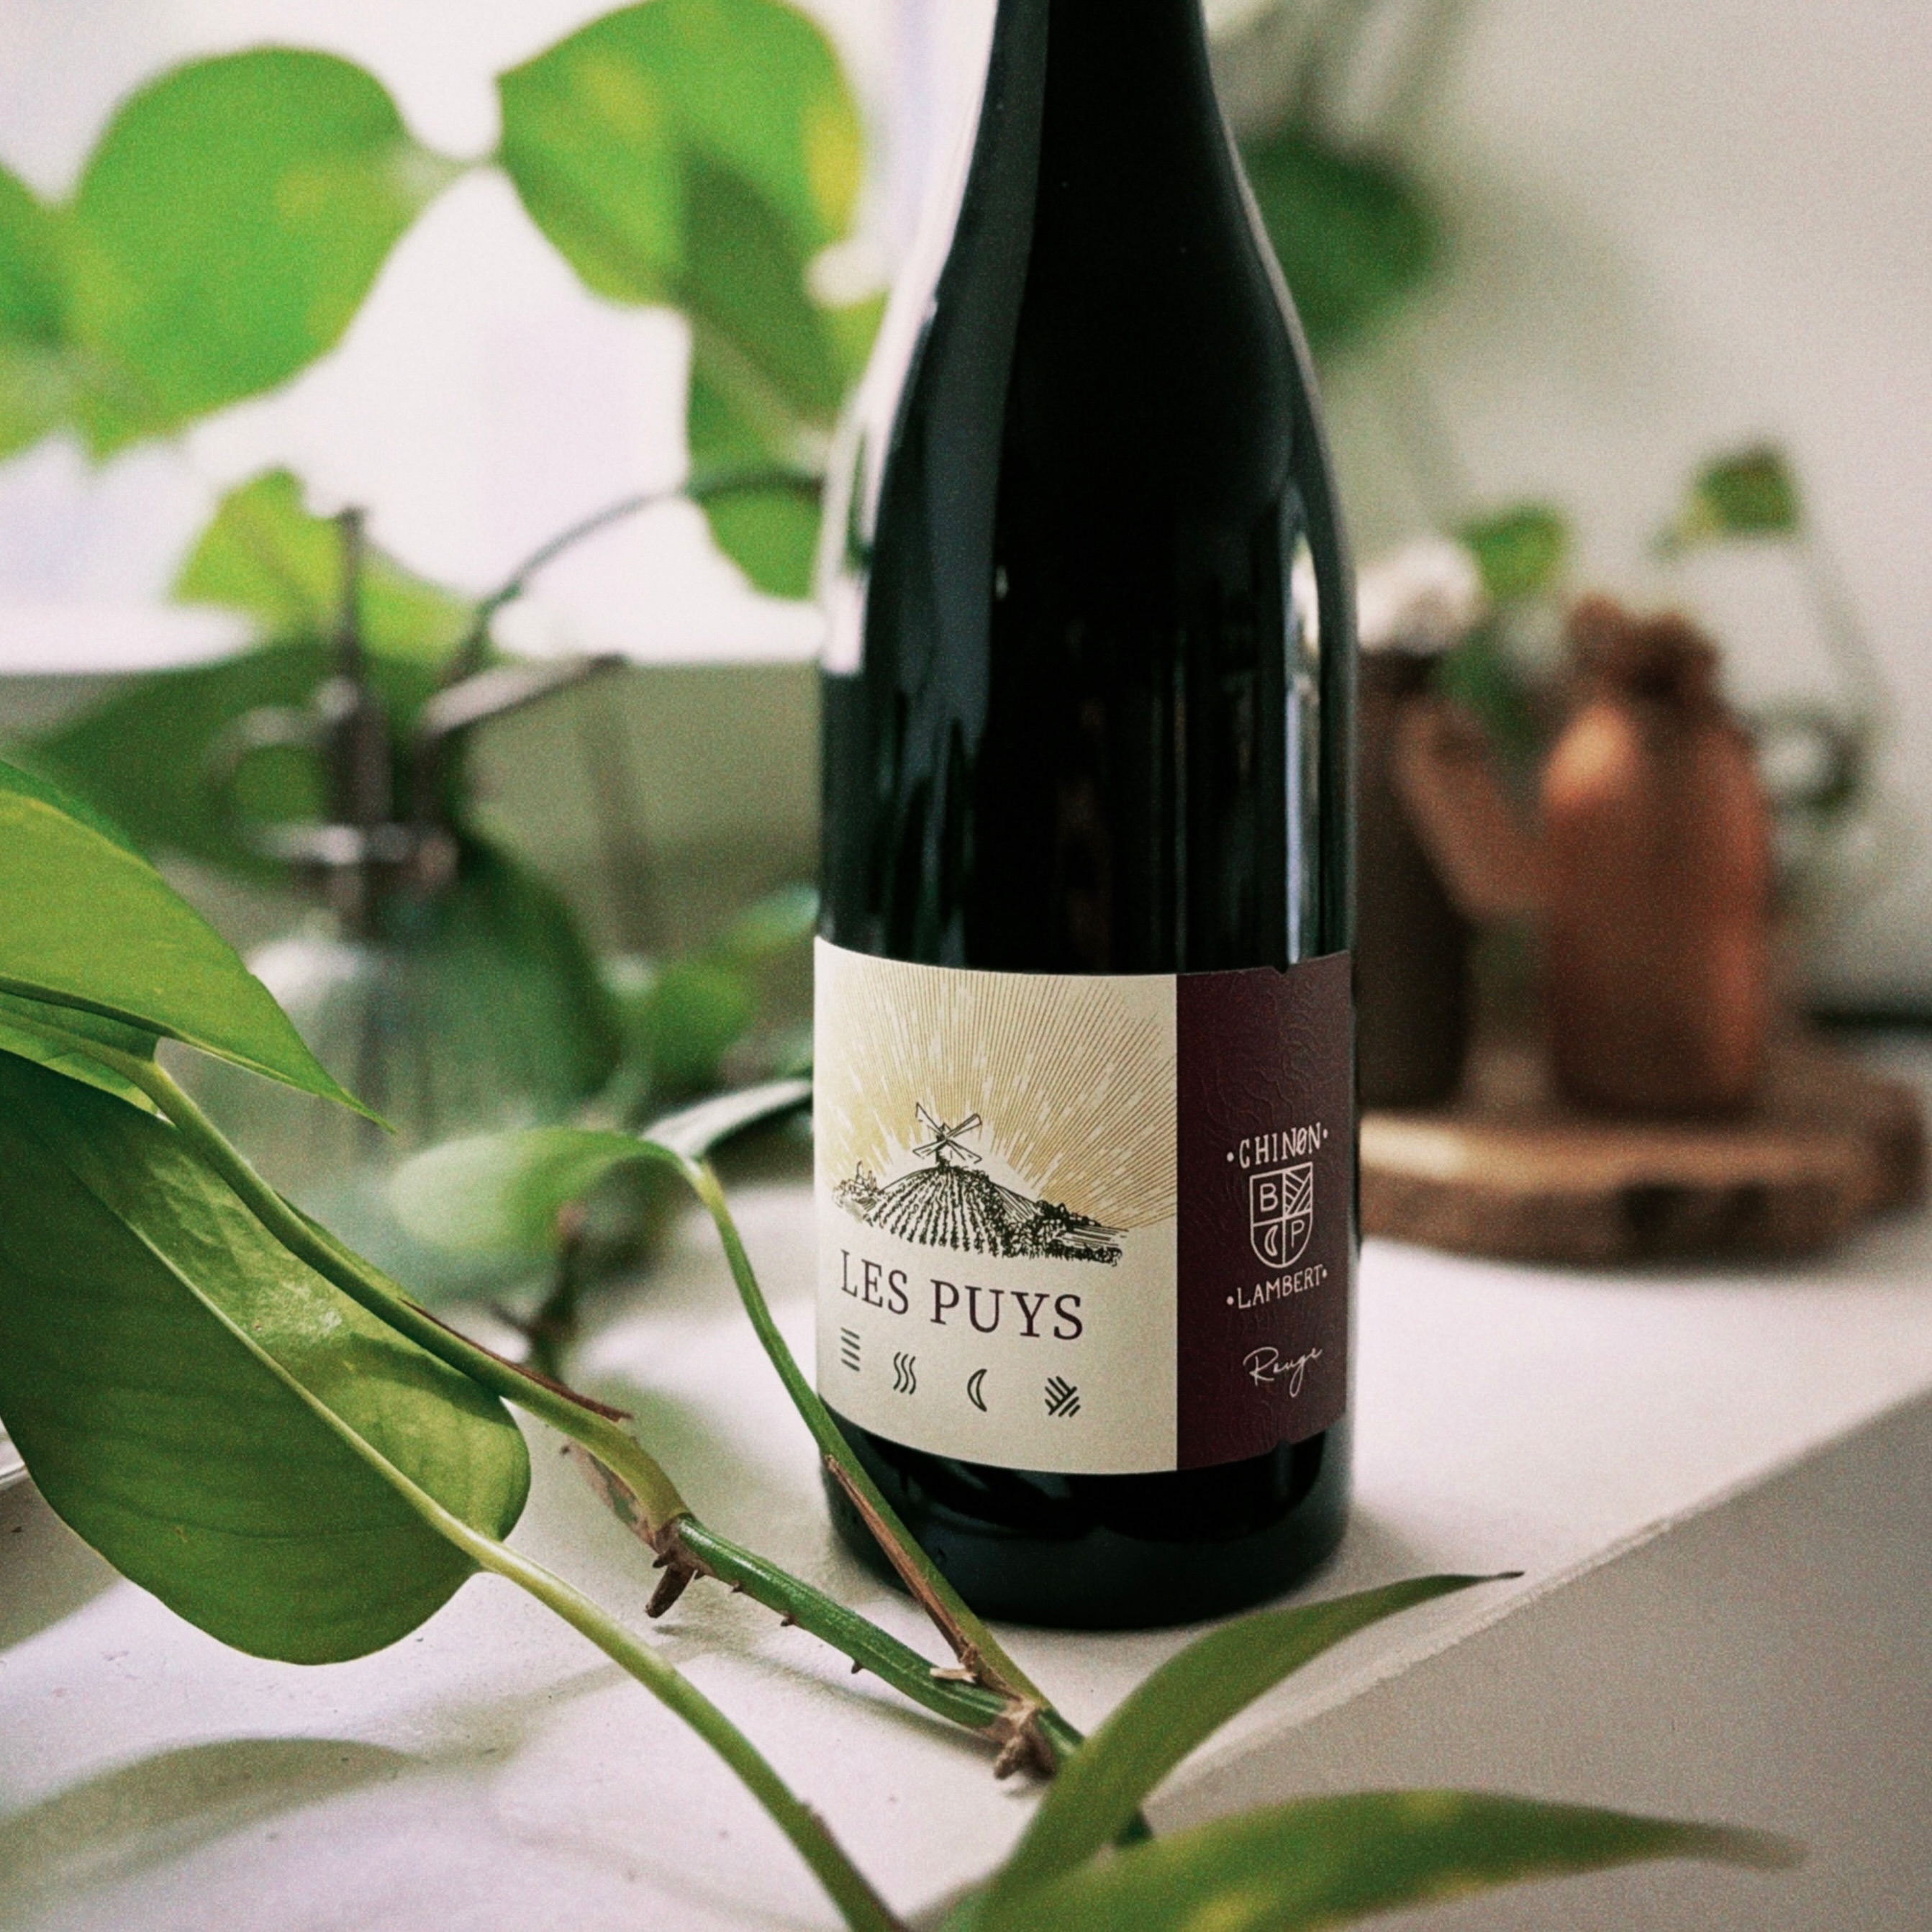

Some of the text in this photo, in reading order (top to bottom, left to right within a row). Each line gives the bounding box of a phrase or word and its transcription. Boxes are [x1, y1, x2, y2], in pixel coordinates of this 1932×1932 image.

[1259, 1182, 1279, 1213] B
[1291, 1219, 1305, 1248] P
[840, 1248, 1083, 1341] LES PUYS
[1237, 1264, 1323, 1309] LAMBERT
